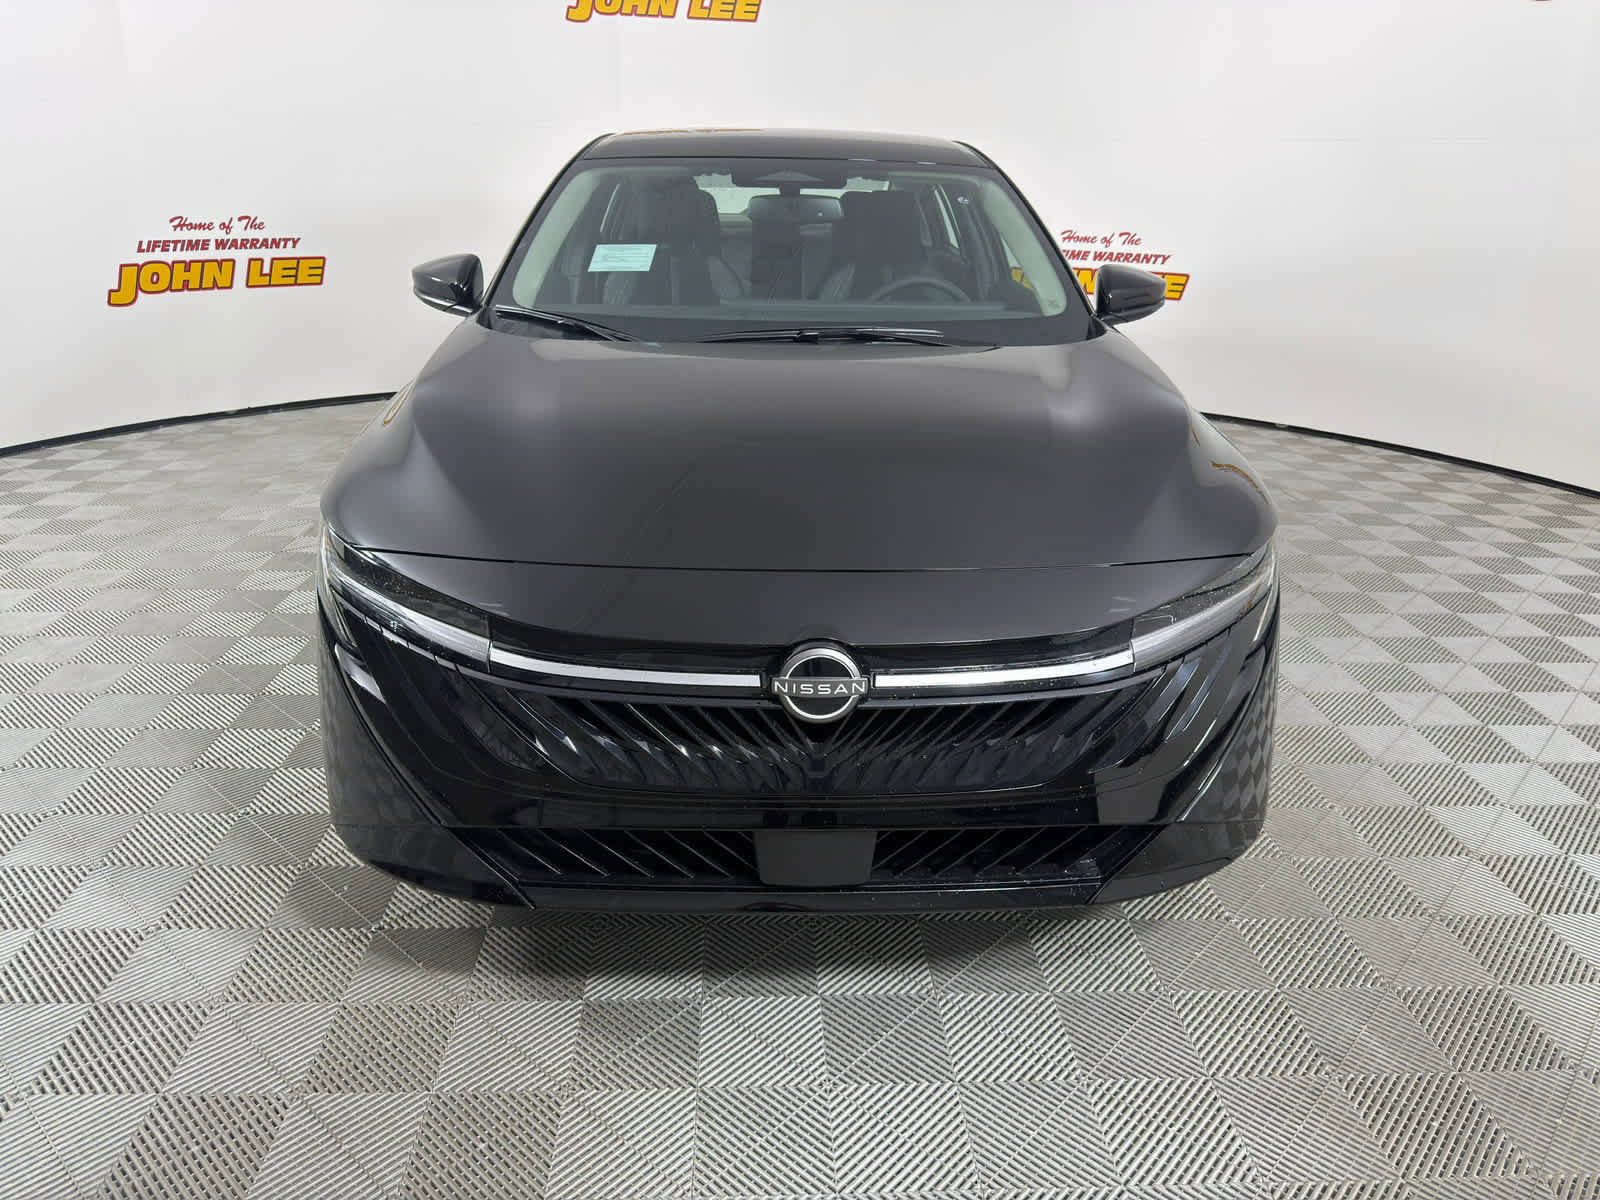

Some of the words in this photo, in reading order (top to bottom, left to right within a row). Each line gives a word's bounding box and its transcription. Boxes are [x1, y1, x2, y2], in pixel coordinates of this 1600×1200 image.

[687, 0, 762, 22] LEE
[168, 215, 214, 231] Home
[219, 217, 232, 234] of
[237, 215, 265, 231] The
[137, 238, 210, 253] LIFETIME
[214, 237, 301, 250] WARRANTY
[1061, 229, 1097, 244] Home
[1100, 232, 1115, 247] of
[1118, 231, 1142, 246] The
[1093, 251, 1171, 265] WARRANTY
[107, 258, 235, 307] JOHN
[246, 256, 326, 288] LEE
[774, 681, 866, 695] NISSAN
